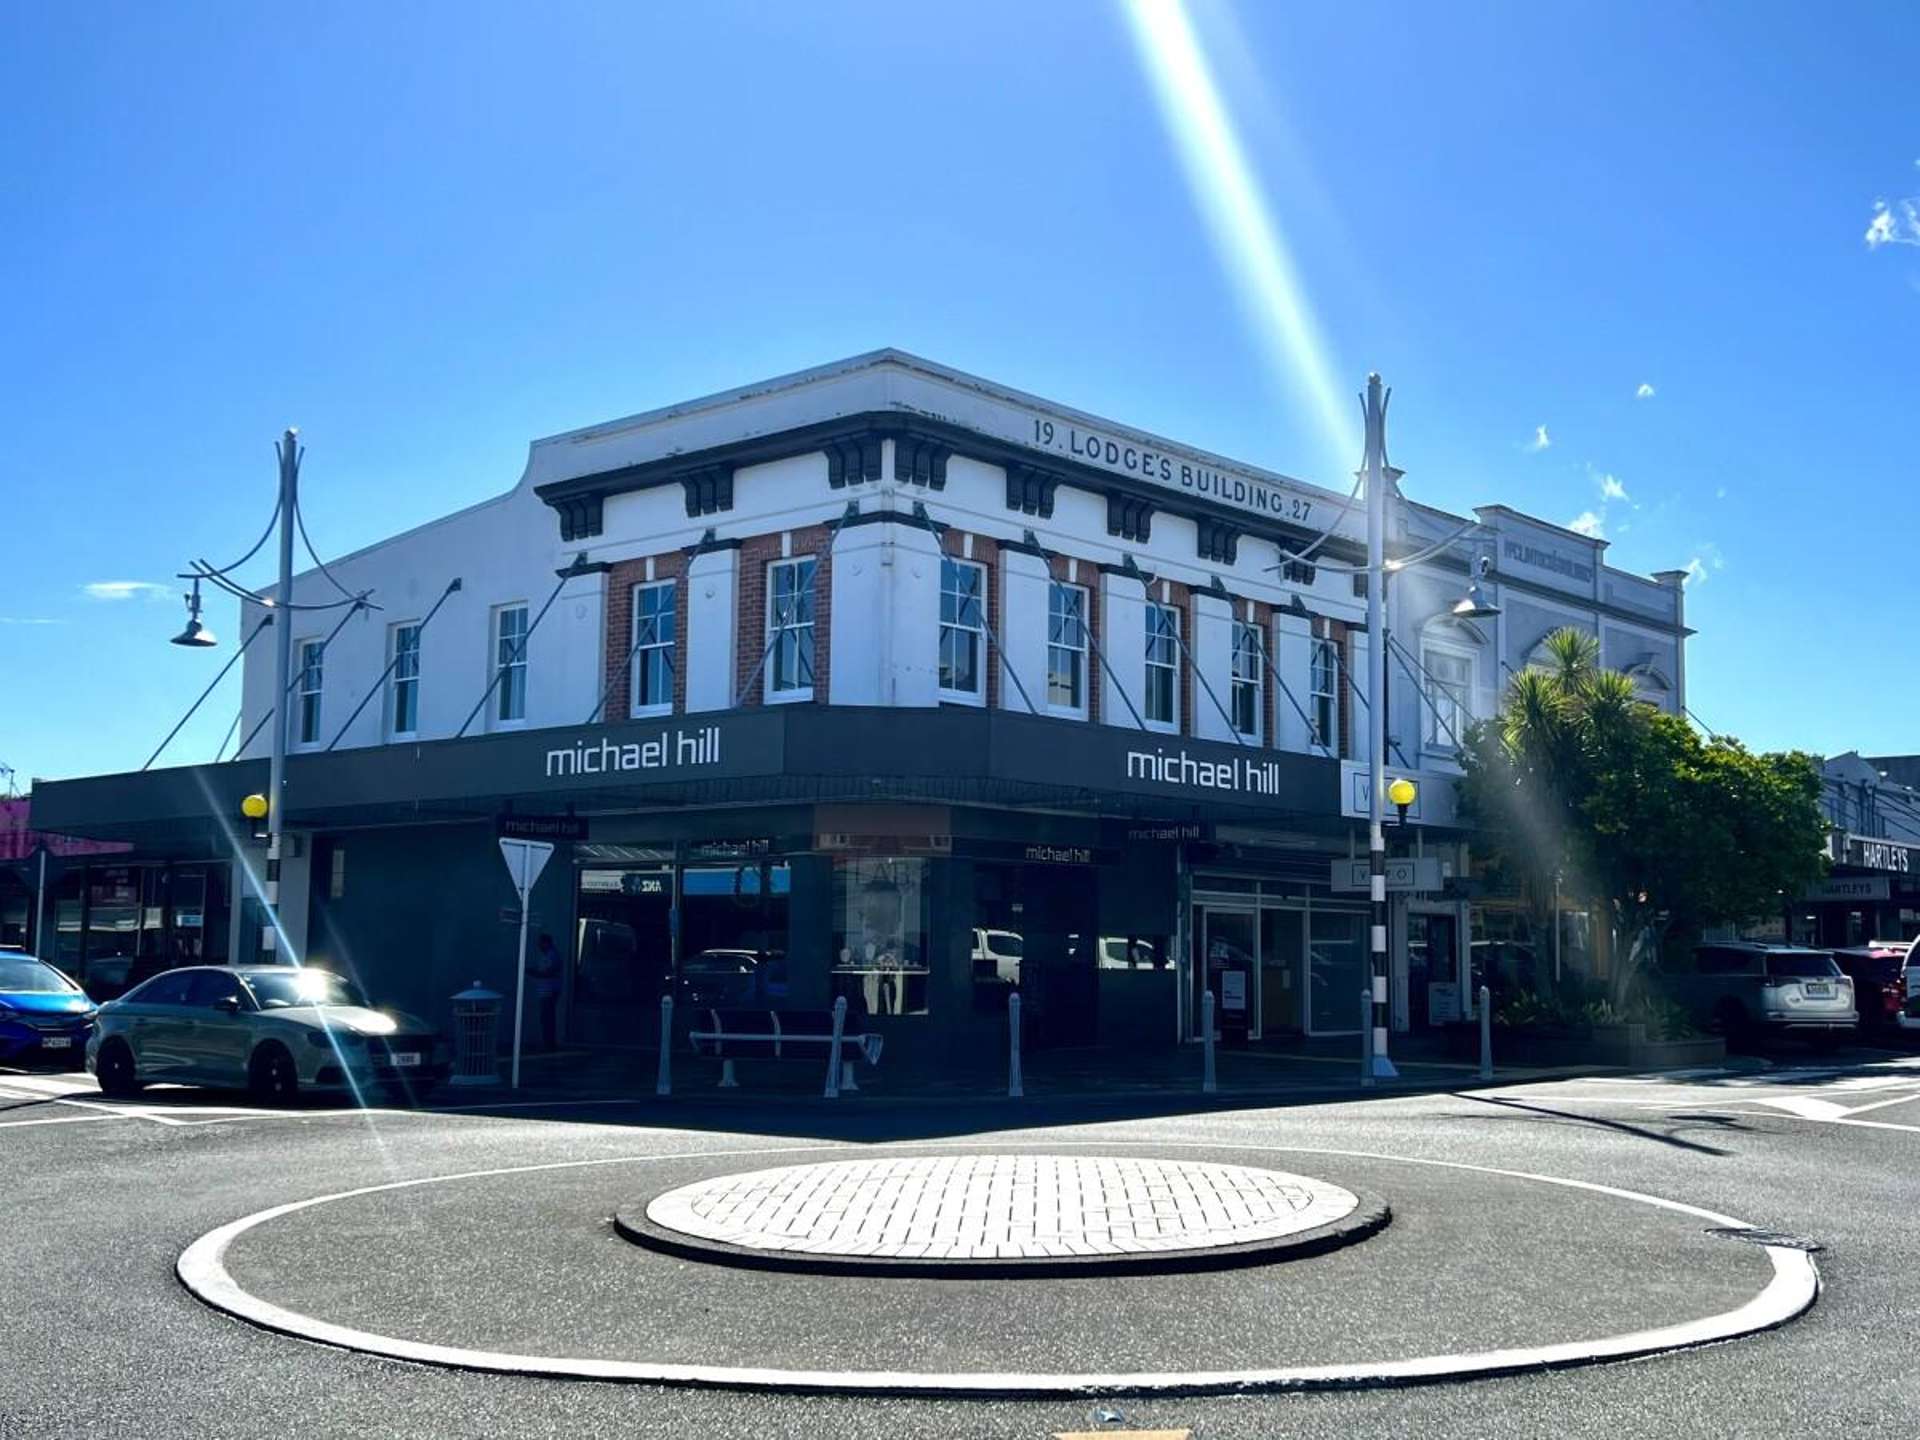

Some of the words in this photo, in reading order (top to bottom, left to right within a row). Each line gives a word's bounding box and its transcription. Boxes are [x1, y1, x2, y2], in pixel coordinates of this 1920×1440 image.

[1070, 430, 1172, 481] LODGE'S
[546, 732, 667, 777] michael
[676, 726, 720, 766] hill
[1127, 748, 1239, 790] michael
[1245, 759, 1279, 795] hill
[1128, 826, 1178, 841] michael
[1181, 825, 1200, 840] hill
[1025, 846, 1073, 863] michael
[1074, 848, 1092, 863] hill
[1863, 842, 1909, 872] HARTLEYS
